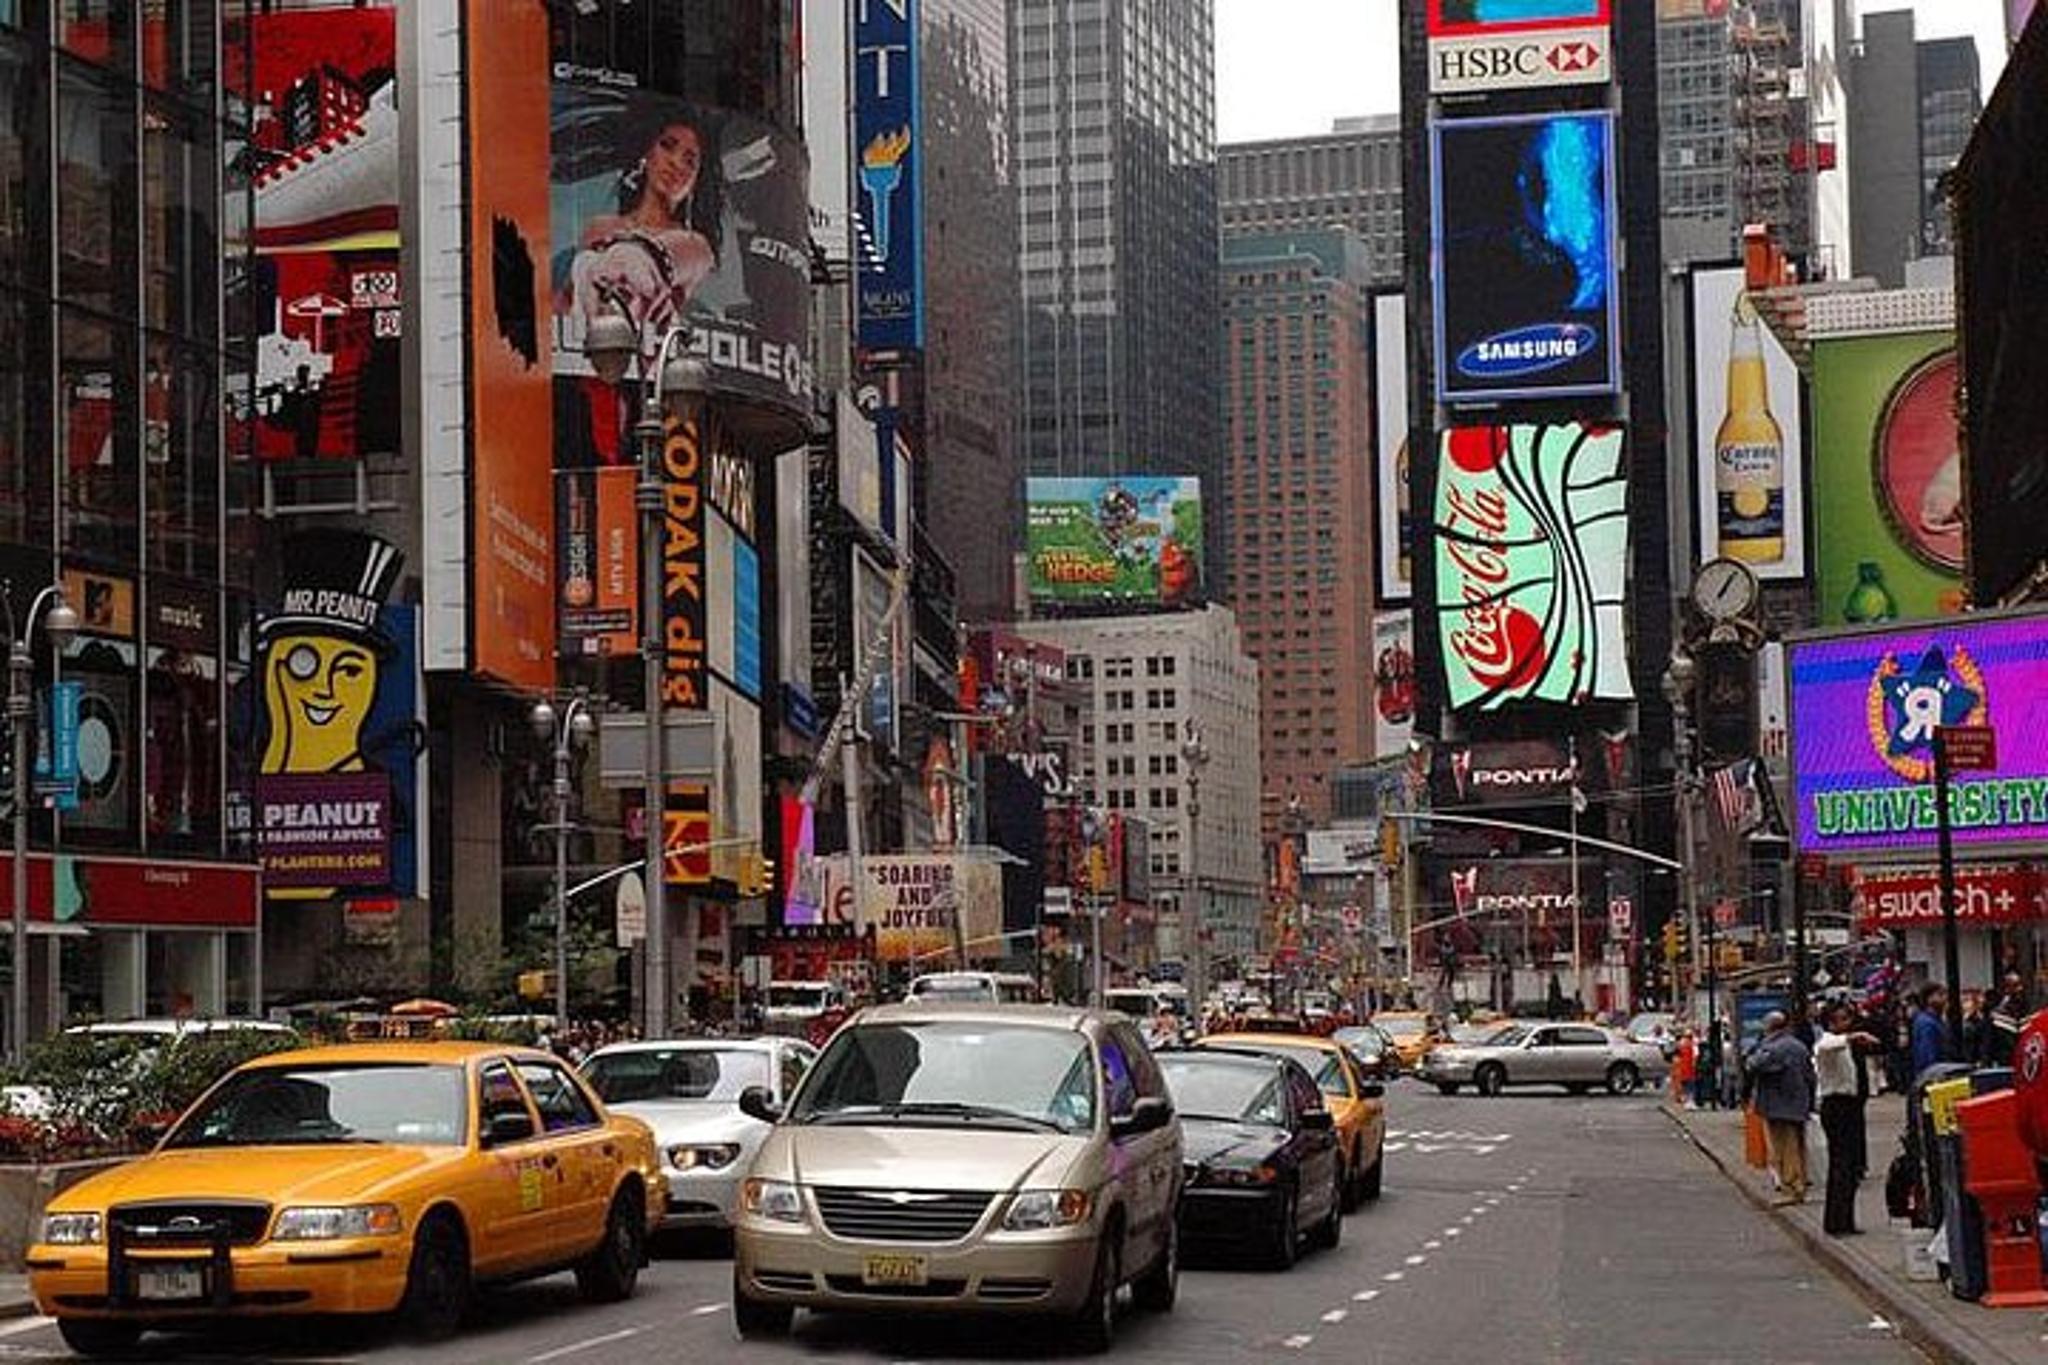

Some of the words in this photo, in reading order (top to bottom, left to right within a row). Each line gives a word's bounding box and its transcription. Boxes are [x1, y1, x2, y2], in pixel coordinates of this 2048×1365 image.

[1440, 45, 1540, 80] HSBC
[1477, 339, 1577, 361] SAMSUNG
[314, 589, 380, 625] PEANUT
[1472, 767, 1575, 786] PONTIA
[264, 801, 381, 827] PEANUT
[1814, 779, 2048, 835] UNIVERSITY
[897, 887, 933, 906] AND
[1477, 894, 1579, 912] PONTIA
[1879, 882, 1990, 919] swatch
